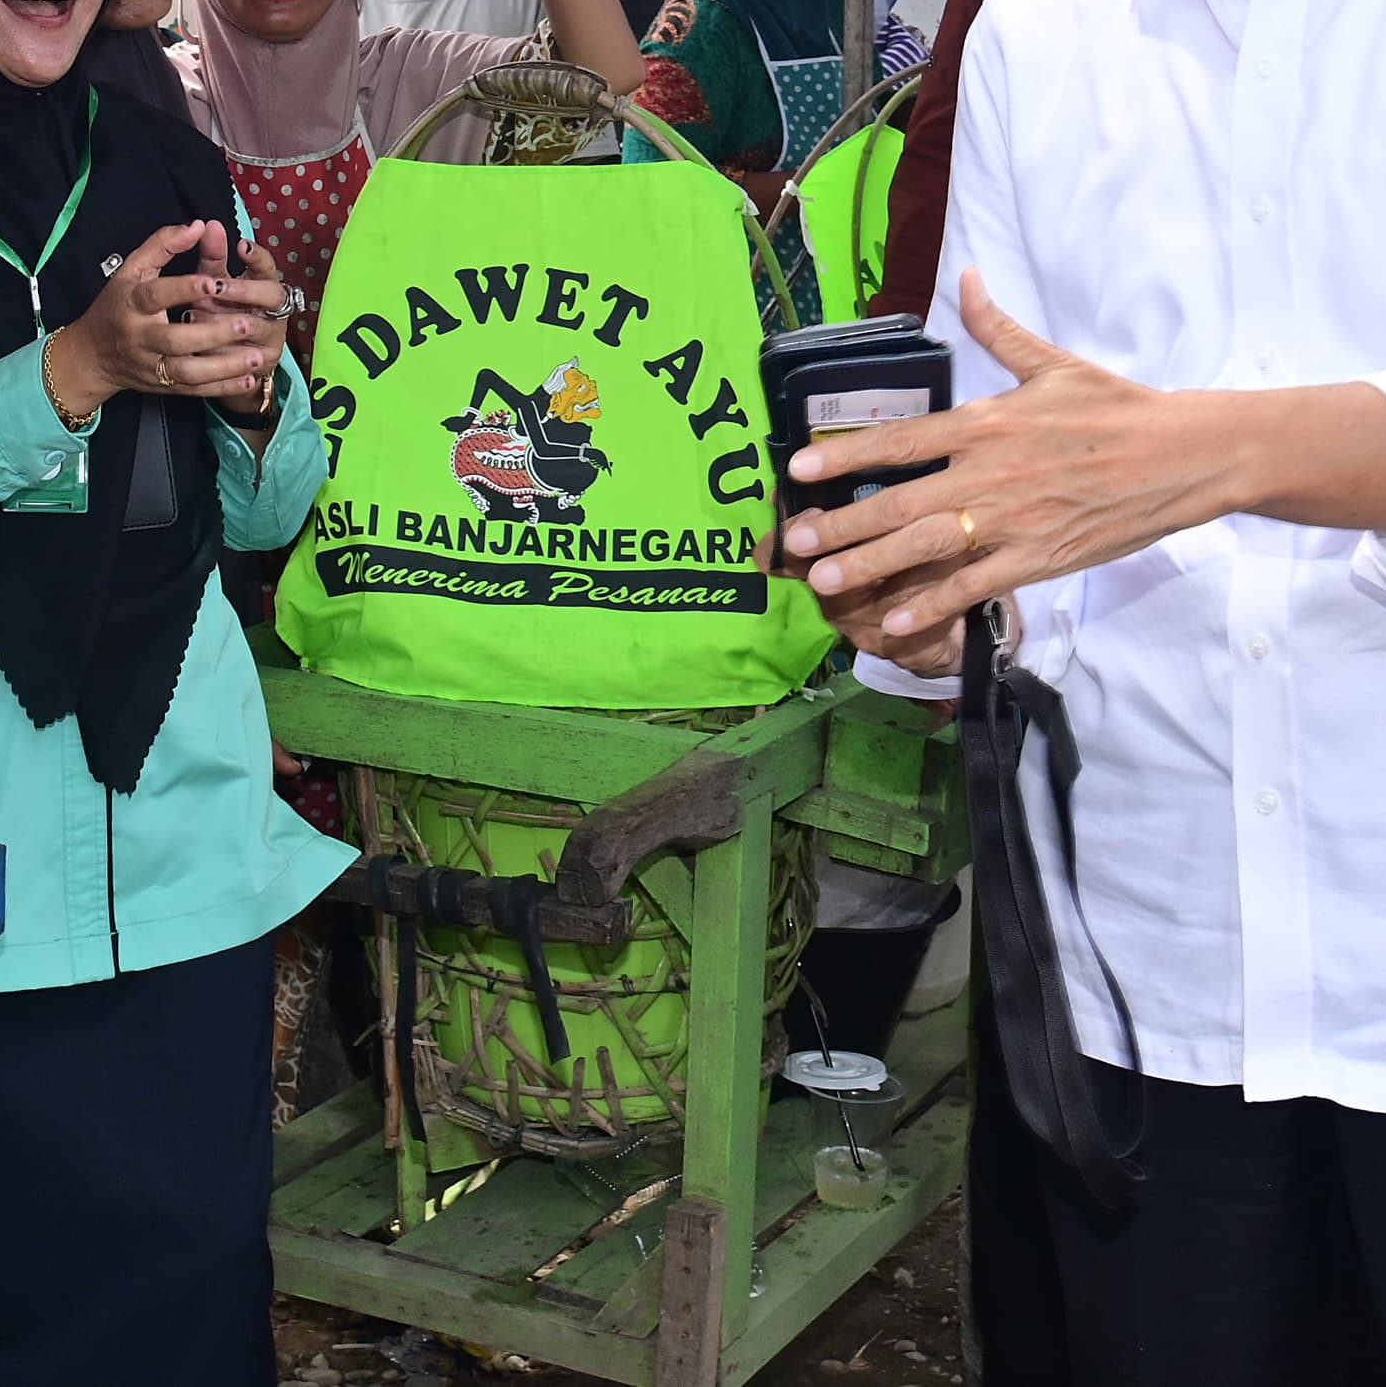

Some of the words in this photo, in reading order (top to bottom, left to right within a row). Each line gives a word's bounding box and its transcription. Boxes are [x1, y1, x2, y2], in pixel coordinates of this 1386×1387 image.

[336, 263, 650, 380] DAWET
[643, 339, 764, 505] AYU
[315, 500, 380, 545] ASLI
[396, 509, 757, 564] BANJARNEGARA
[337, 551, 530, 599] Menerima
[548, 571, 739, 606] Pesanan
